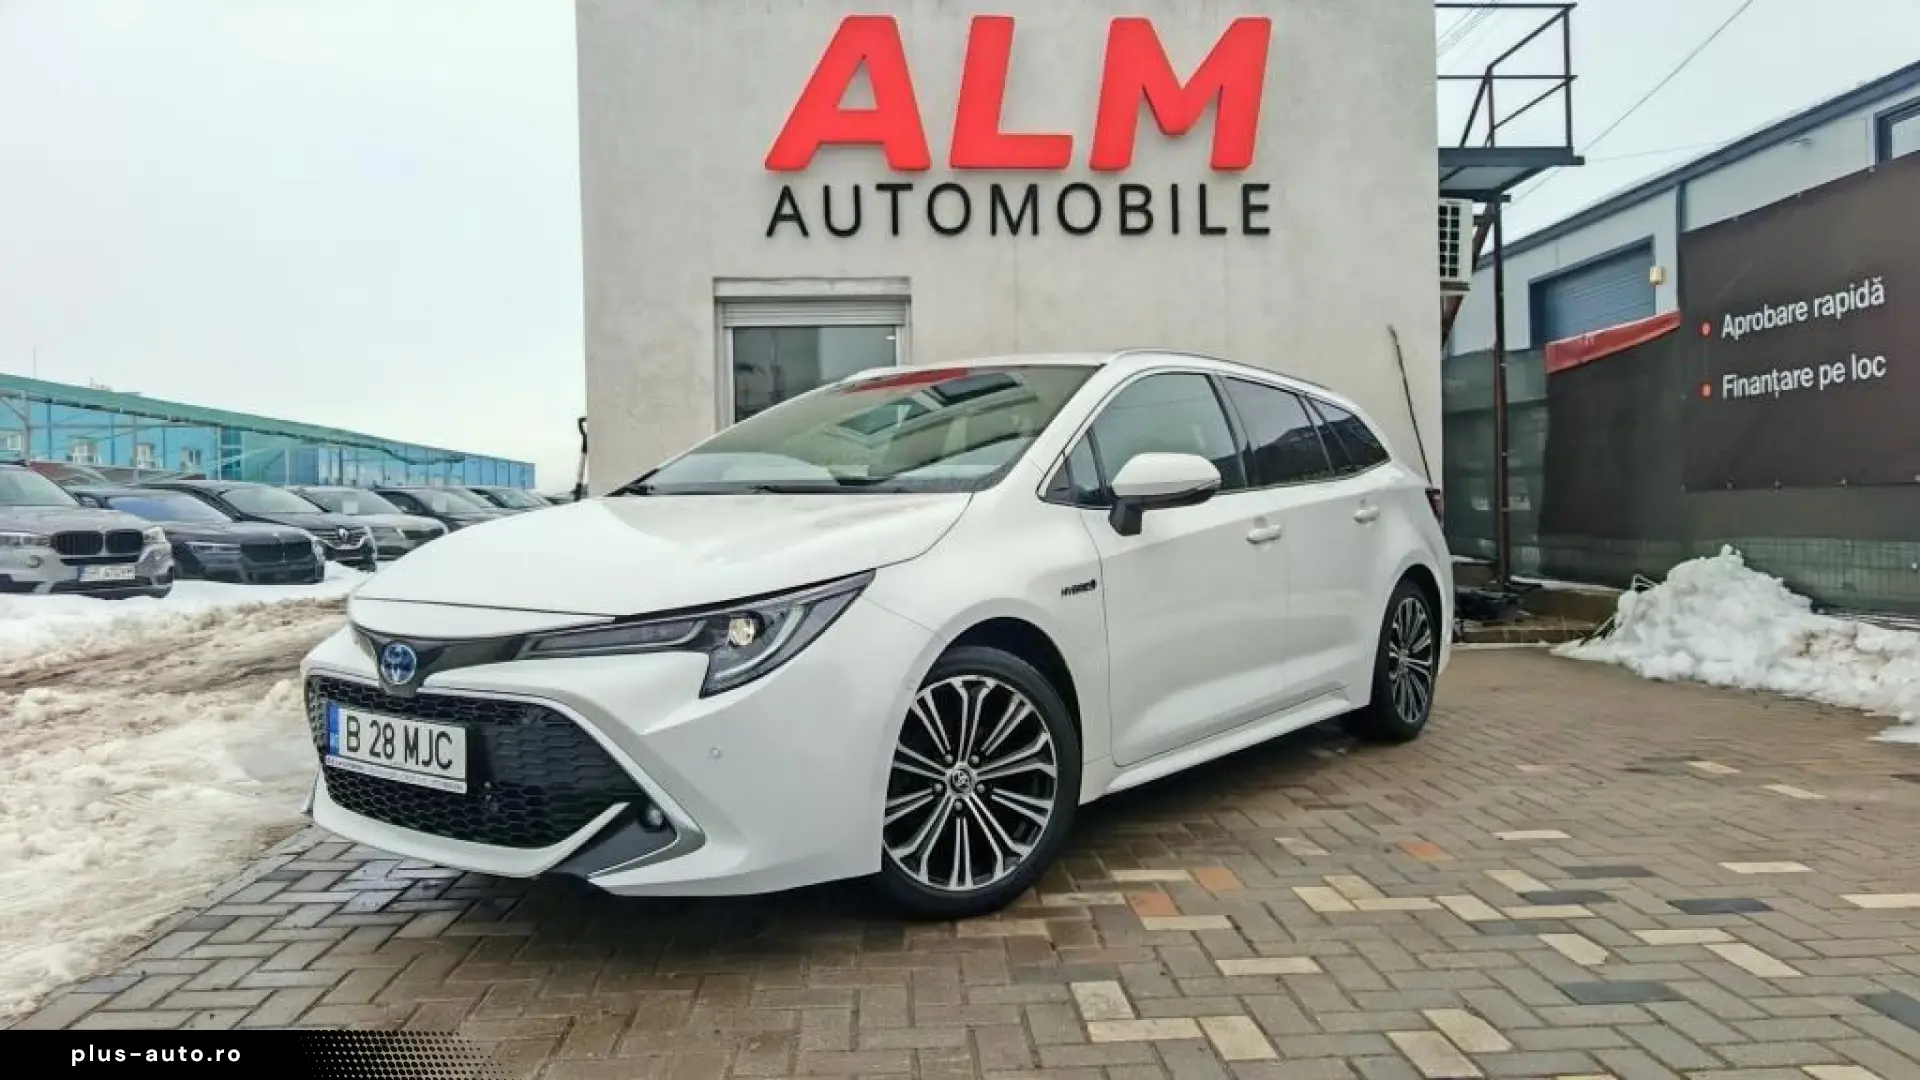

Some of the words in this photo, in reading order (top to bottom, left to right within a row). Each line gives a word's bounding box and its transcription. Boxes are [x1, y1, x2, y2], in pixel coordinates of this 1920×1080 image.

[764, 15, 1271, 171] ALM
[766, 182, 1272, 237] AUTOMOBILE
[1721, 301, 1809, 340] Aprobare
[1814, 275, 1885, 320] rapidă
[1722, 366, 1814, 399] Finanțare
[1818, 361, 1846, 391] pe
[1851, 353, 1887, 381] loc
[346, 715, 361, 752] B
[369, 719, 395, 759] 28
[404, 725, 453, 770] MJC
